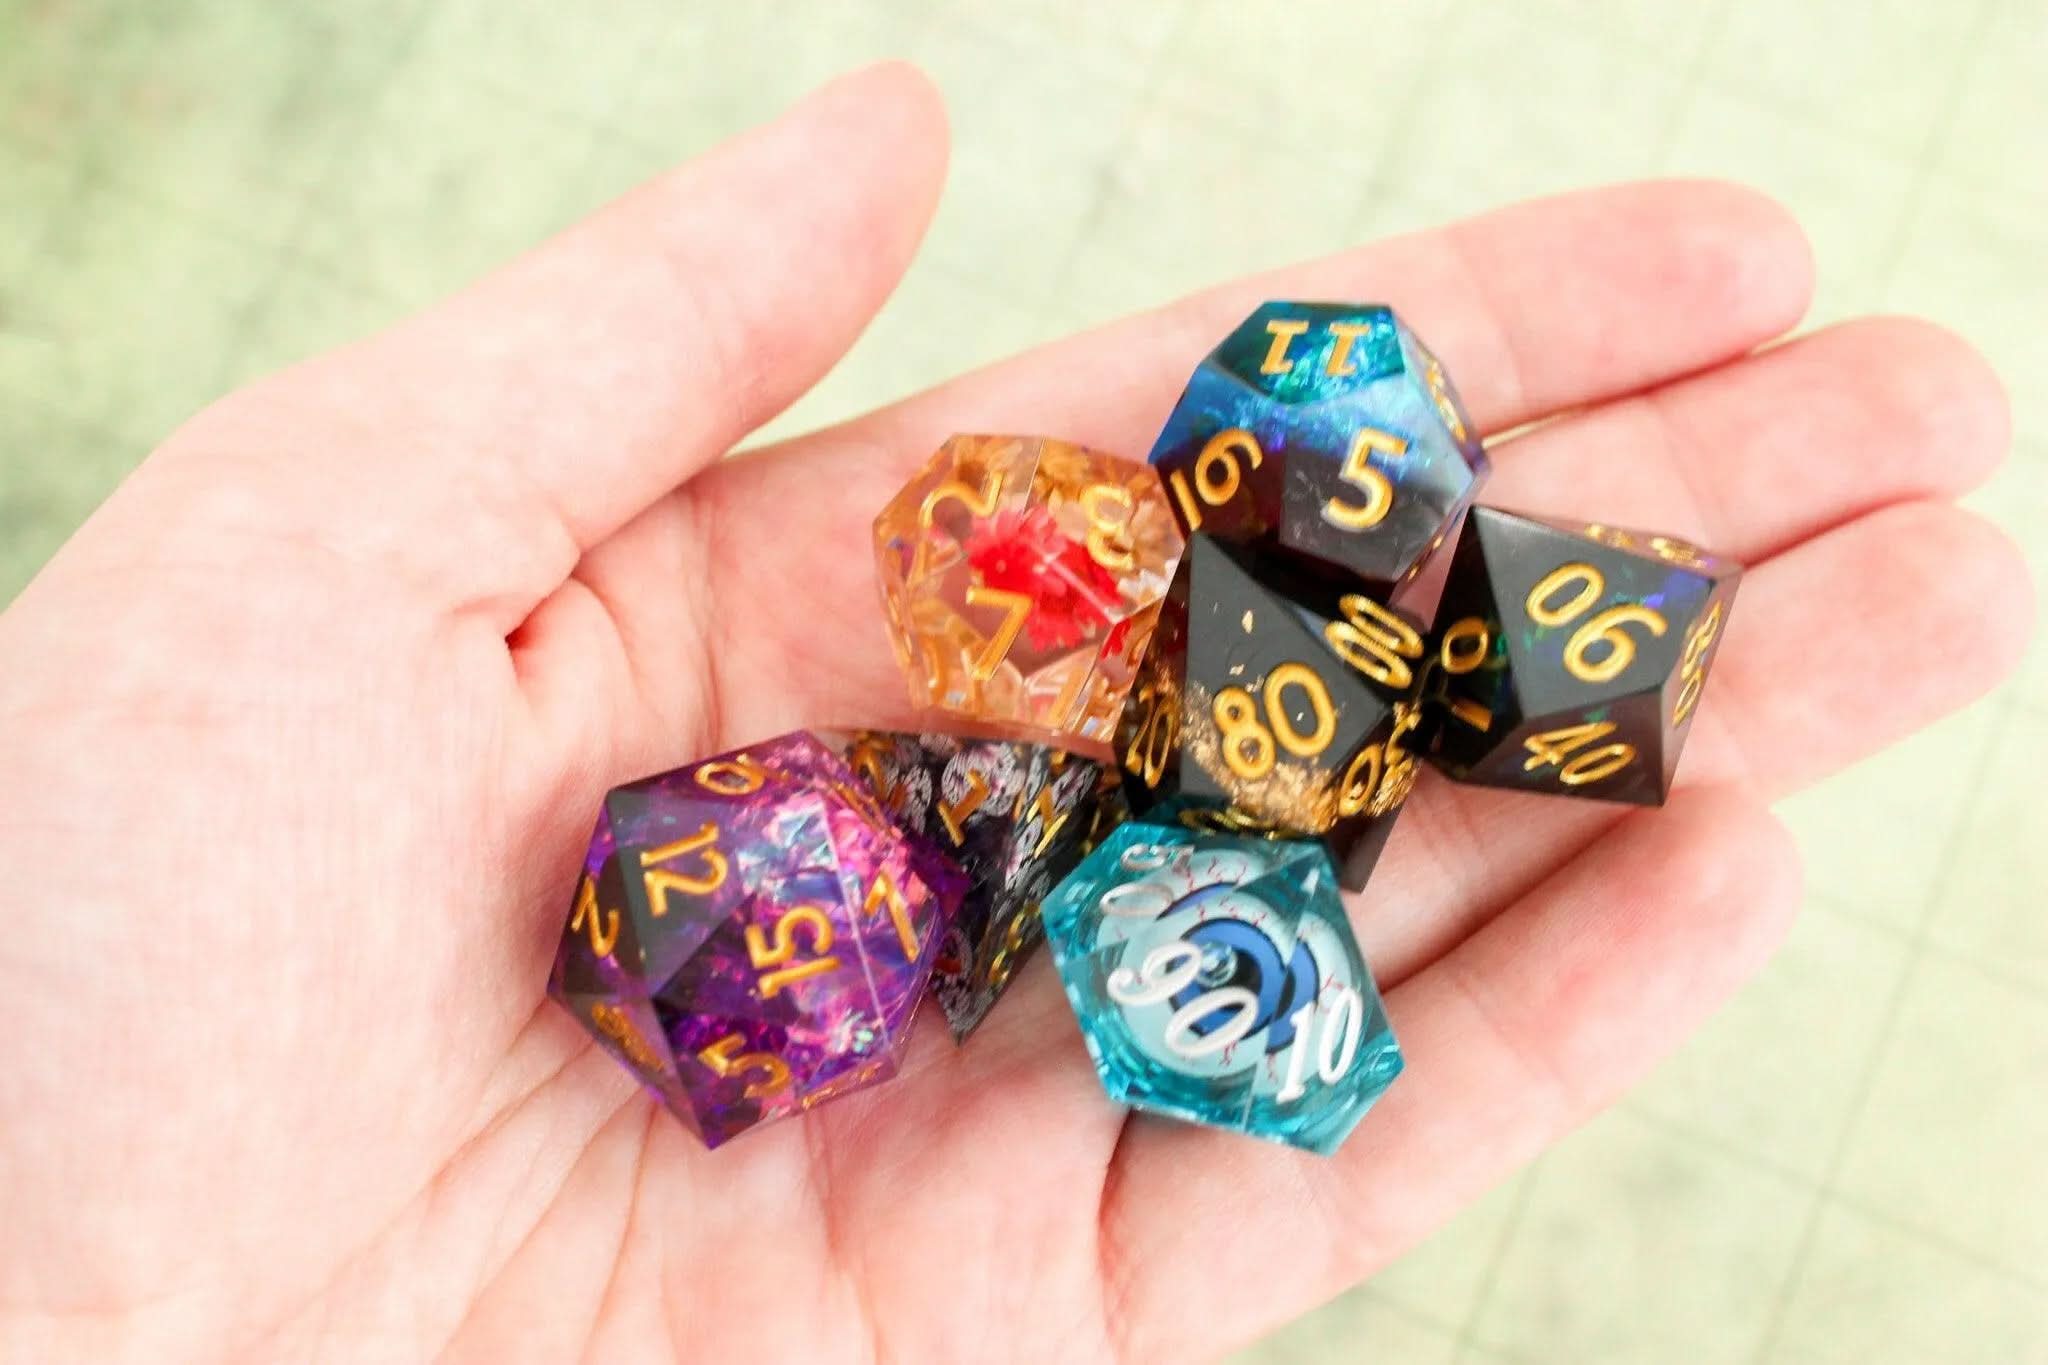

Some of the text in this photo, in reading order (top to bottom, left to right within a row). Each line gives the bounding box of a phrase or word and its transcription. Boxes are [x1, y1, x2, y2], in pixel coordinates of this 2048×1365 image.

[1260, 319, 1372, 377] 11
[1320, 426, 1409, 533] 5
[965, 587, 1035, 682] 7
[1212, 661, 1339, 802] 80
[1523, 721, 1636, 786] 40
[571, 874, 621, 958] 2
[640, 819, 729, 919] 12
[742, 904, 842, 999] 15
[1106, 940, 1259, 1058] 90
[698, 1031, 790, 1099] 5
[1276, 987, 1364, 1106] 10
